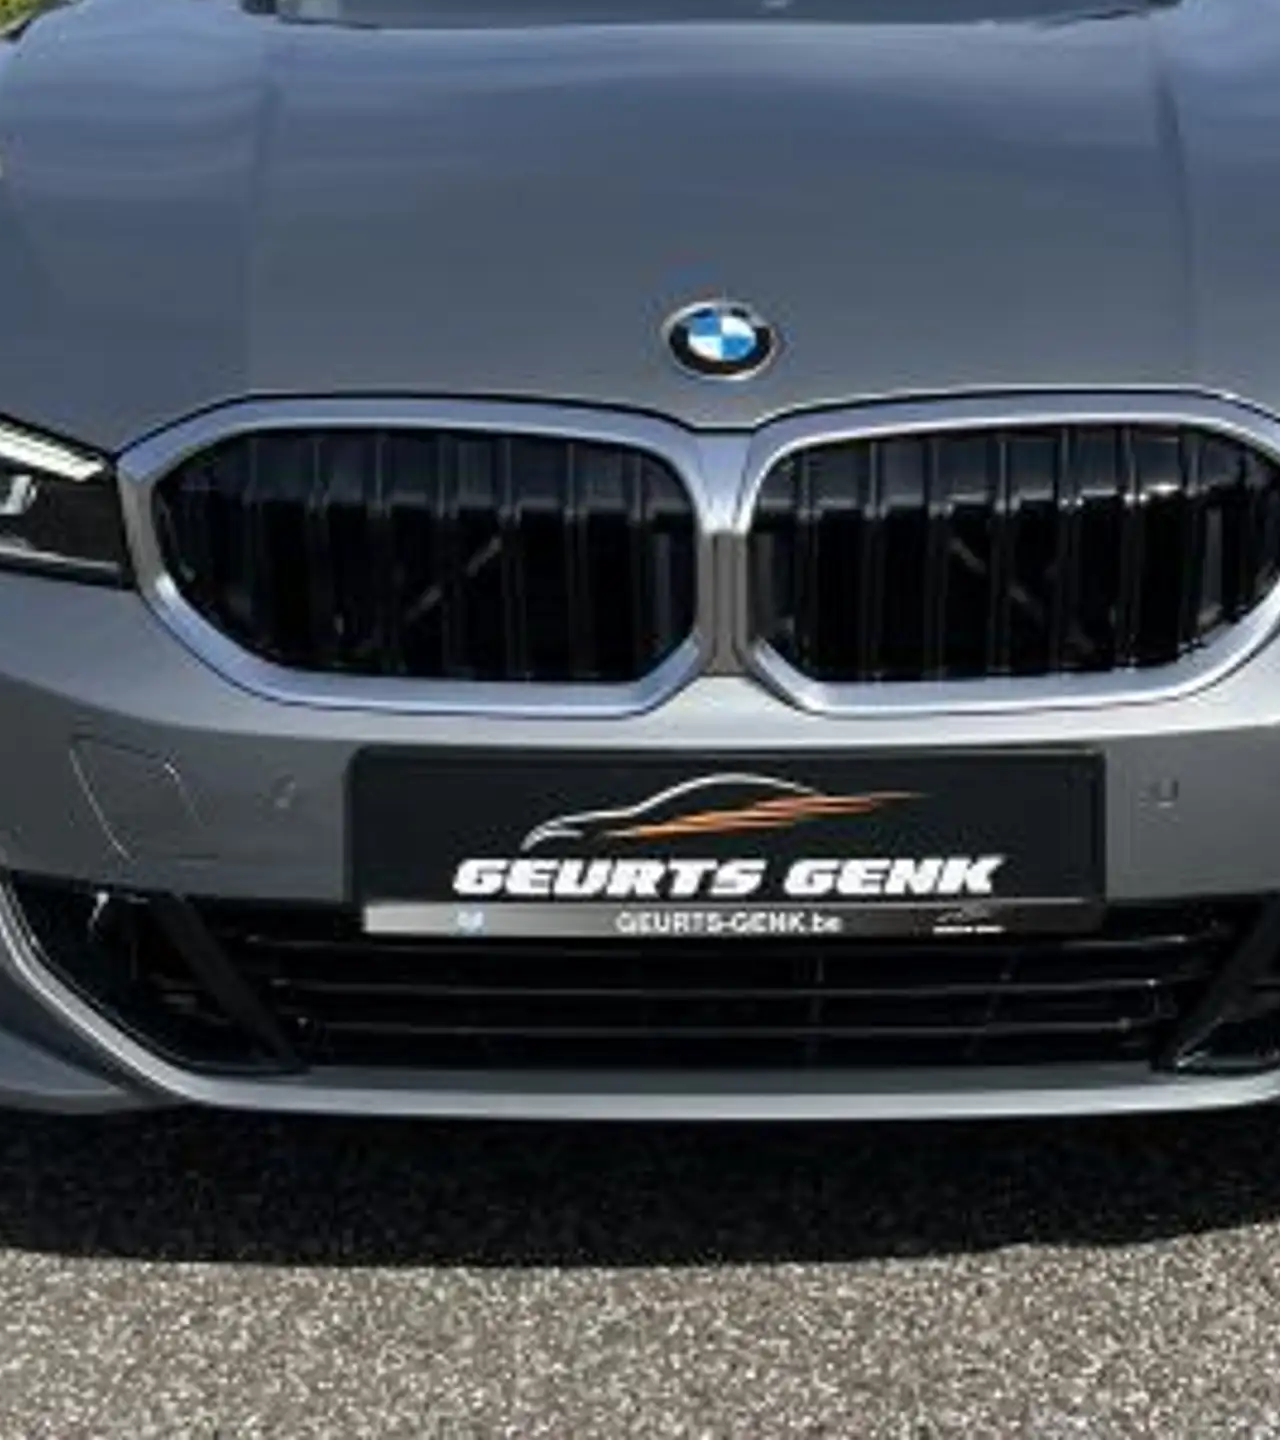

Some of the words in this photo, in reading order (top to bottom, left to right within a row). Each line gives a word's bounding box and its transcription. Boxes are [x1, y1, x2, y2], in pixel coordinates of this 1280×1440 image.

[453, 859, 766, 896] GEURTS
[783, 856, 1004, 896] GENK
[615, 911, 843, 935] GEURTS-GENK.be
